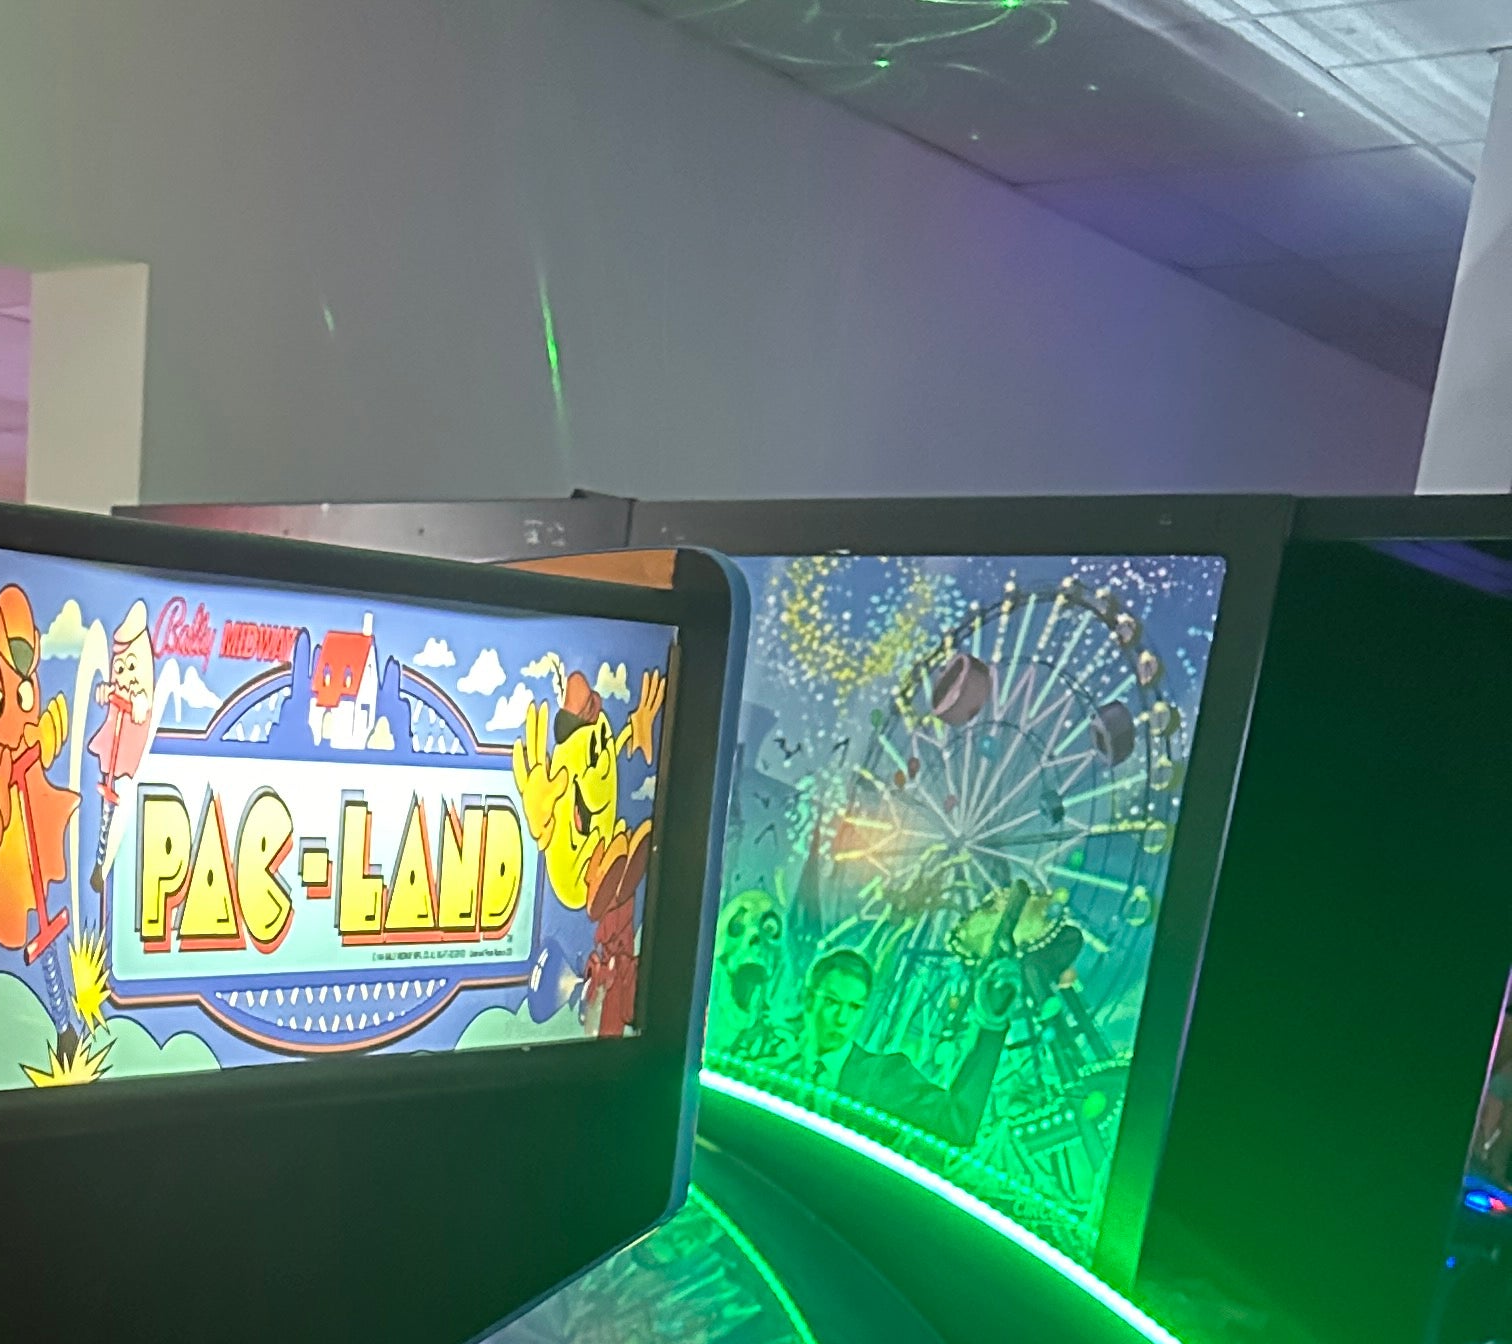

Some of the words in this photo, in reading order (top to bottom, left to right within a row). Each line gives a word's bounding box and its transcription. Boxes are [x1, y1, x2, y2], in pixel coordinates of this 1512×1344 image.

[152, 596, 216, 674] Bally
[219, 619, 302, 663] MIDWAY
[134, 782, 524, 954] PAC-LAND
